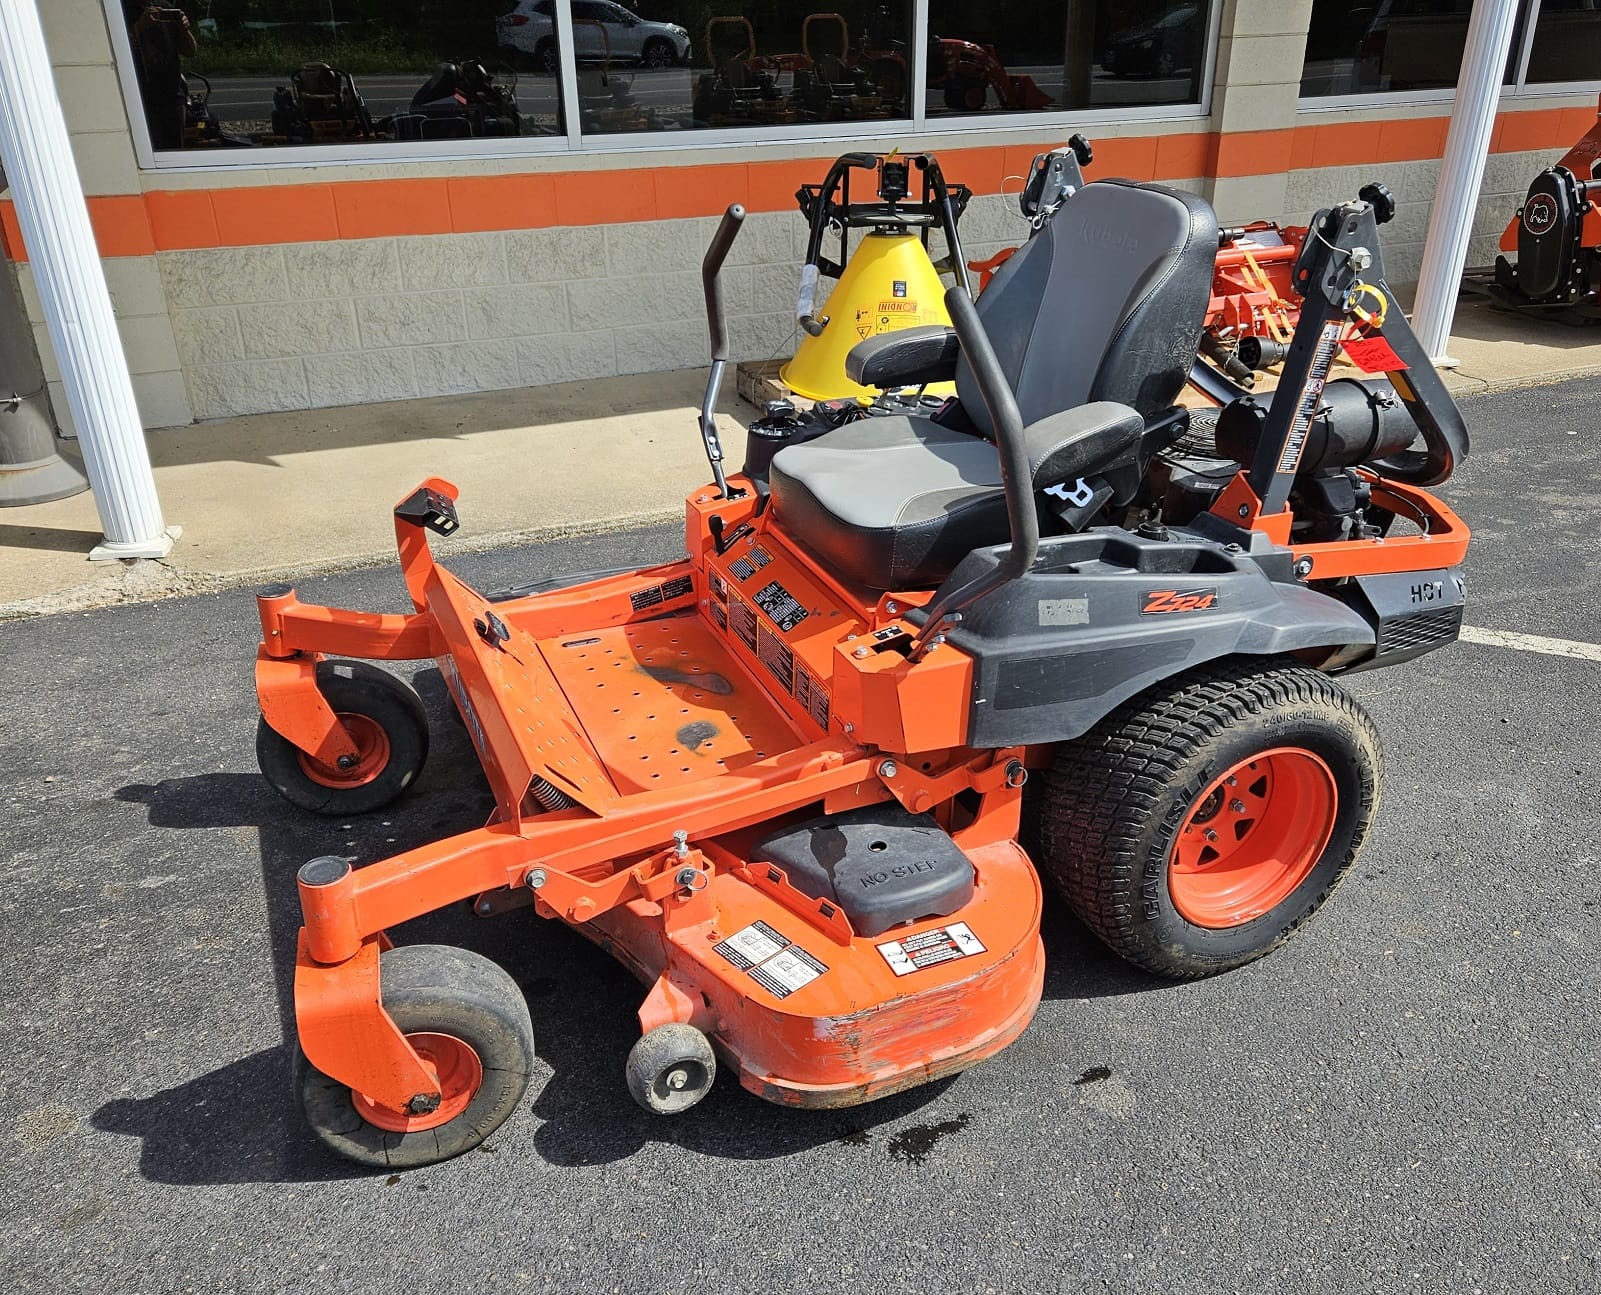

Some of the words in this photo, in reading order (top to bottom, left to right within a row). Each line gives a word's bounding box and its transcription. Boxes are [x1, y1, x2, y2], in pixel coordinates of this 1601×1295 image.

[878, 302, 918, 313] RONDINI
[1143, 589, 1216, 613] Z724
[1411, 580, 1445, 603] HOT
[1142, 758, 1219, 920] CARLISLE
[860, 871, 888, 888] NO
[891, 860, 937, 878] STEP
